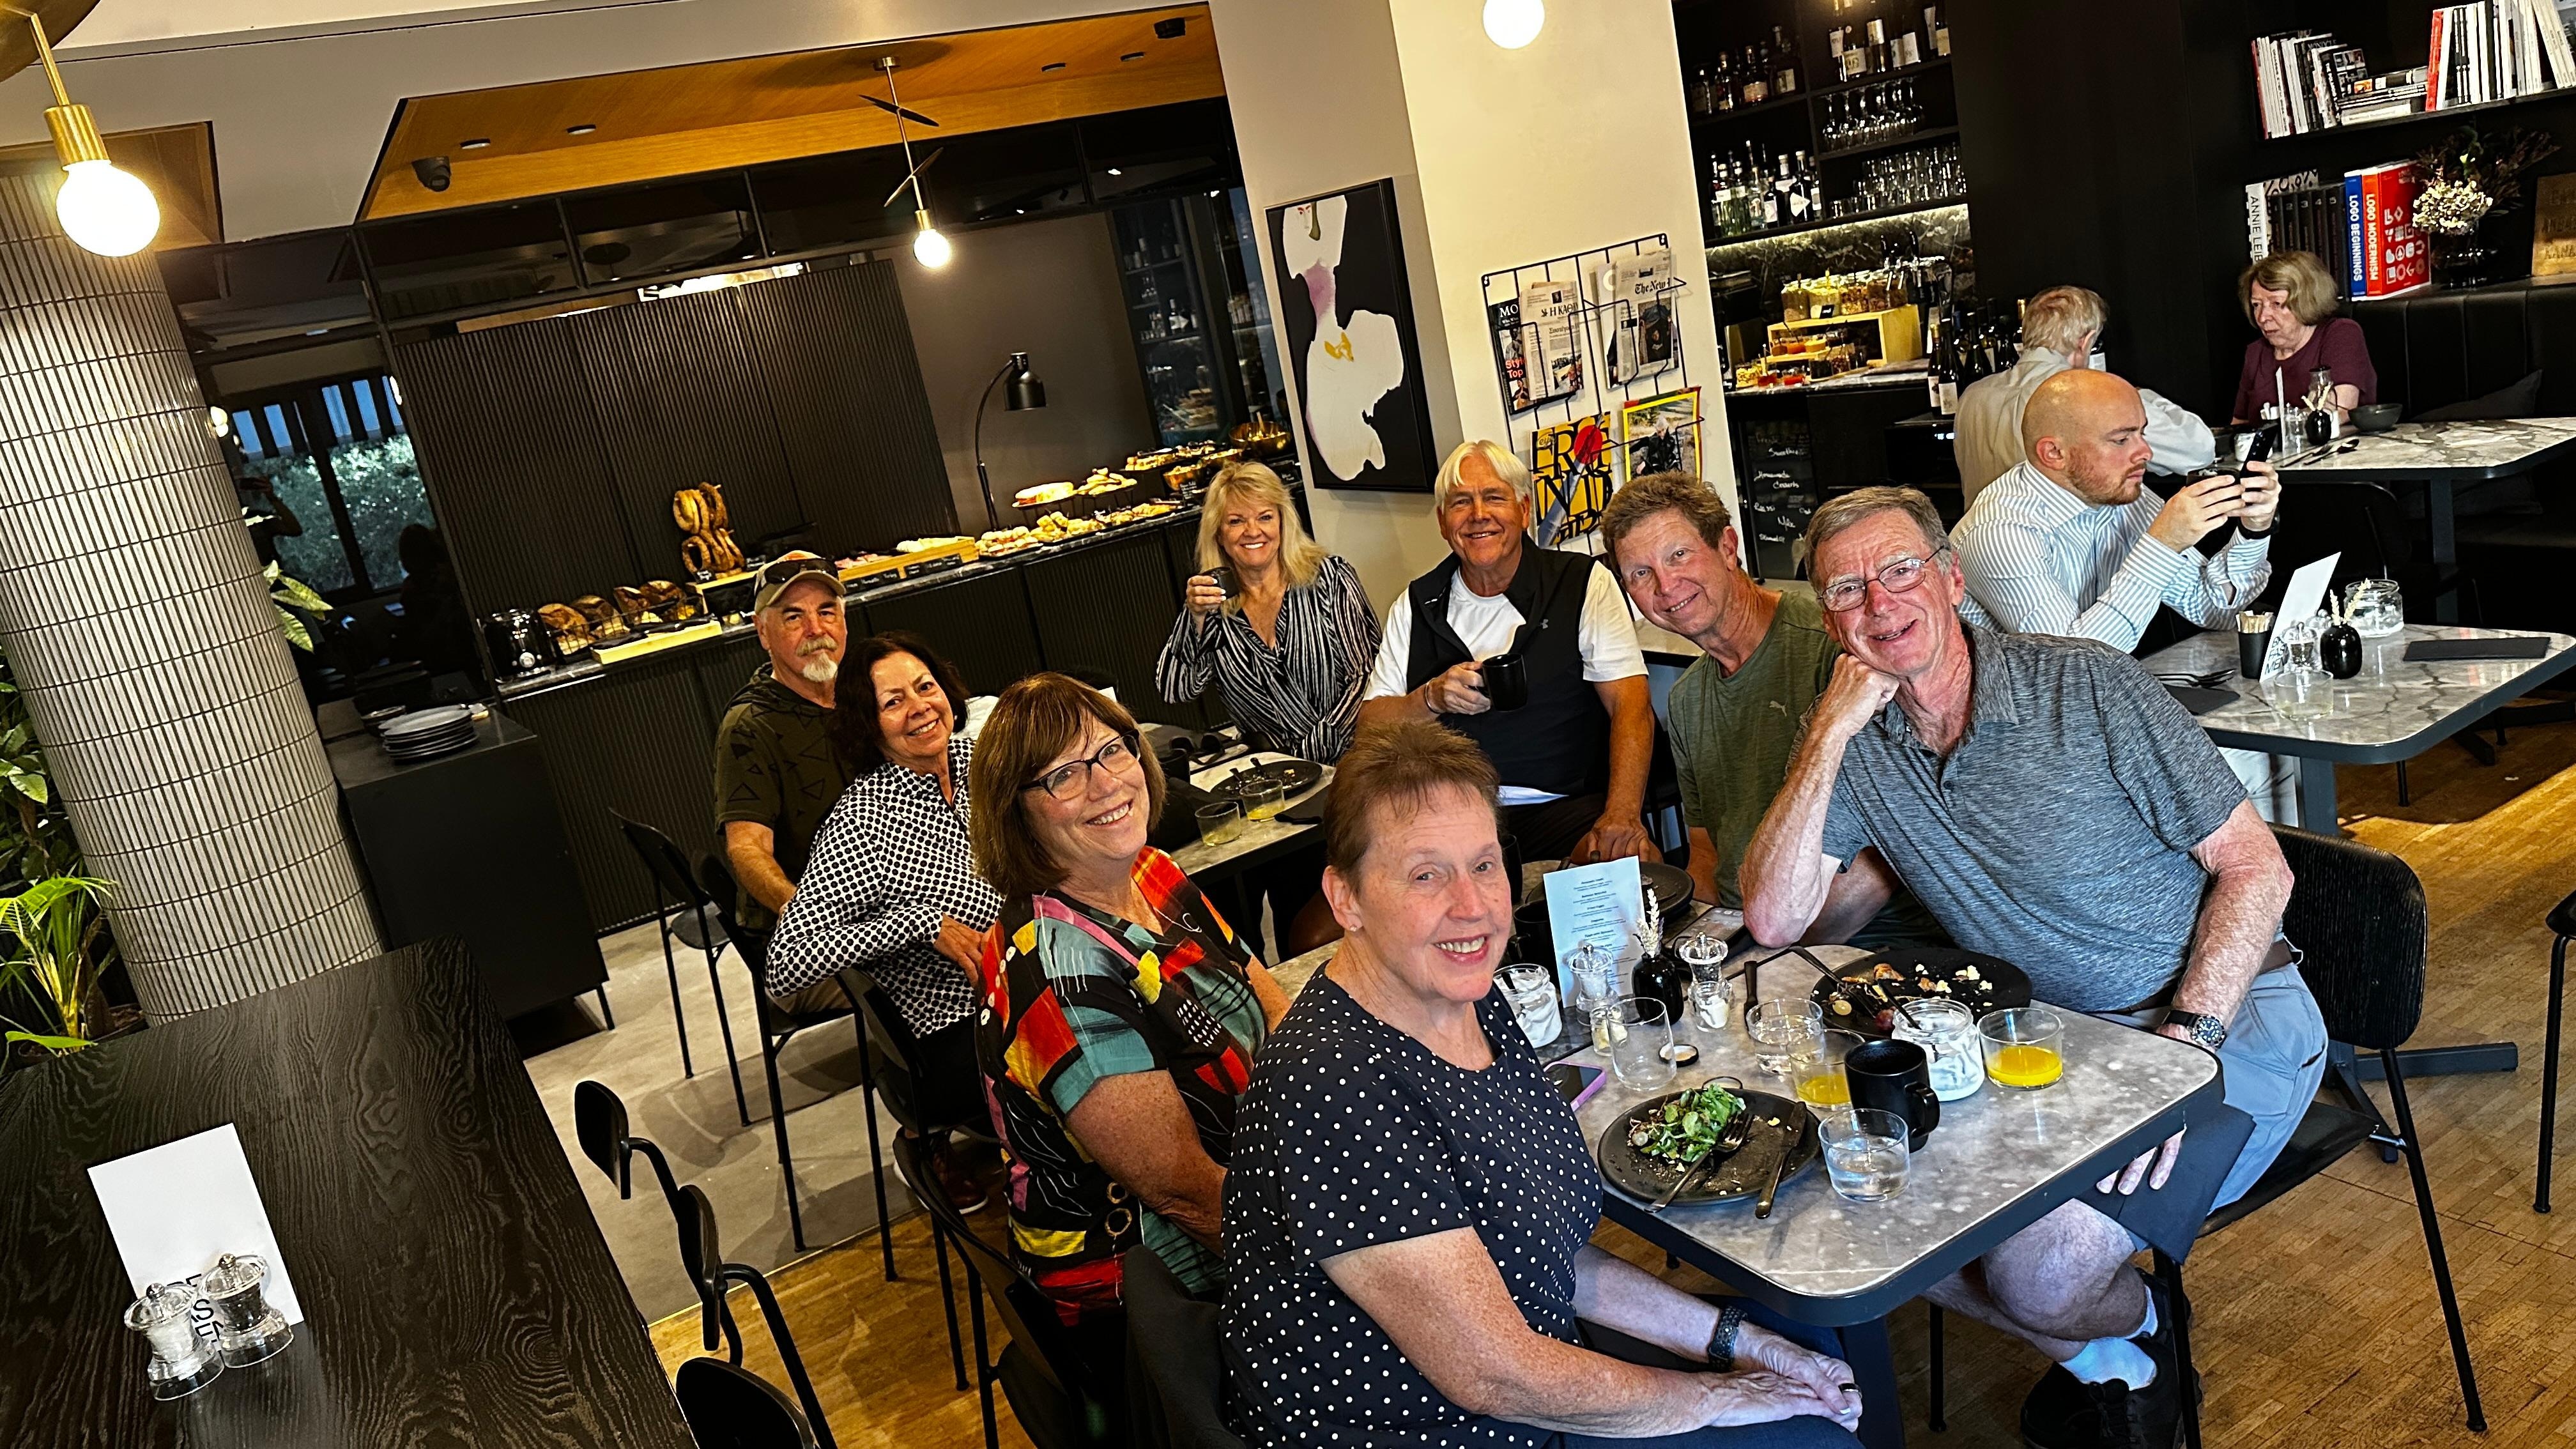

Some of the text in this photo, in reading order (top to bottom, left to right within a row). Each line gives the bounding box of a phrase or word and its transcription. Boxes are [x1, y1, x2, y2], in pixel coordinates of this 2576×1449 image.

[2250, 195, 2261, 233] ANNIE
[2349, 194, 2363, 282] LOGO BEGINNINGS
[2366, 194, 2378, 280] LOGO MODERNISM
[1634, 283, 1649, 295] The
